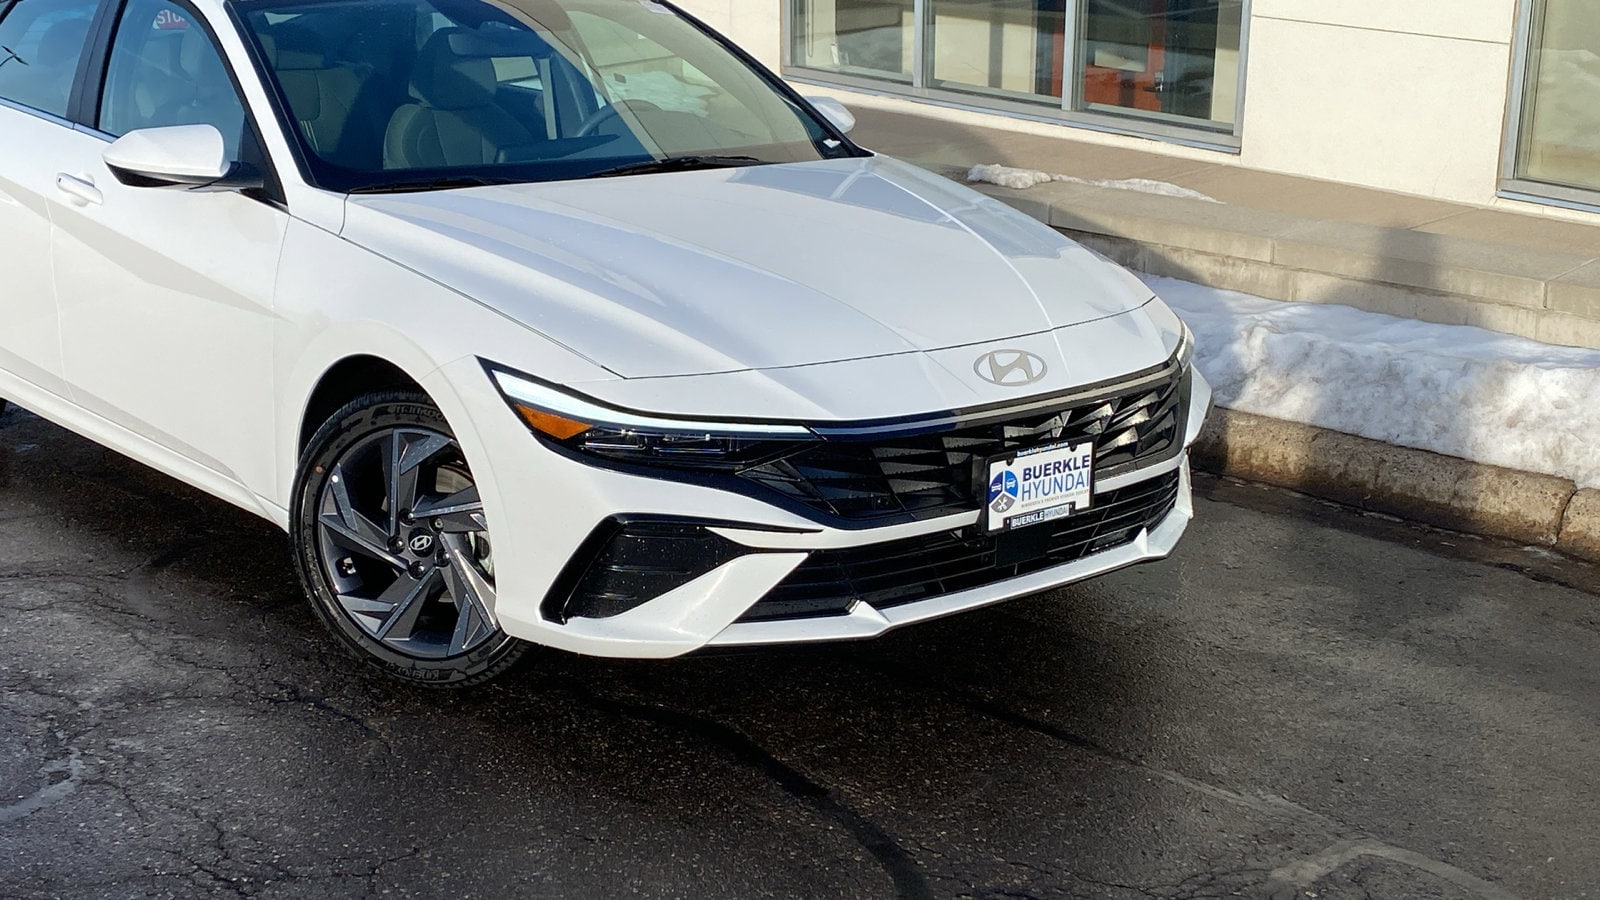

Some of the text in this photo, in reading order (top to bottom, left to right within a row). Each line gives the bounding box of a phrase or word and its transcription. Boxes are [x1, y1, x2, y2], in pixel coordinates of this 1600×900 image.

[156, 9, 185, 24] STO
[1022, 455, 1090, 482] BUERKLE
[1022, 470, 1089, 501] HYUNDAI
[1012, 512, 1044, 527] BUERKLE
